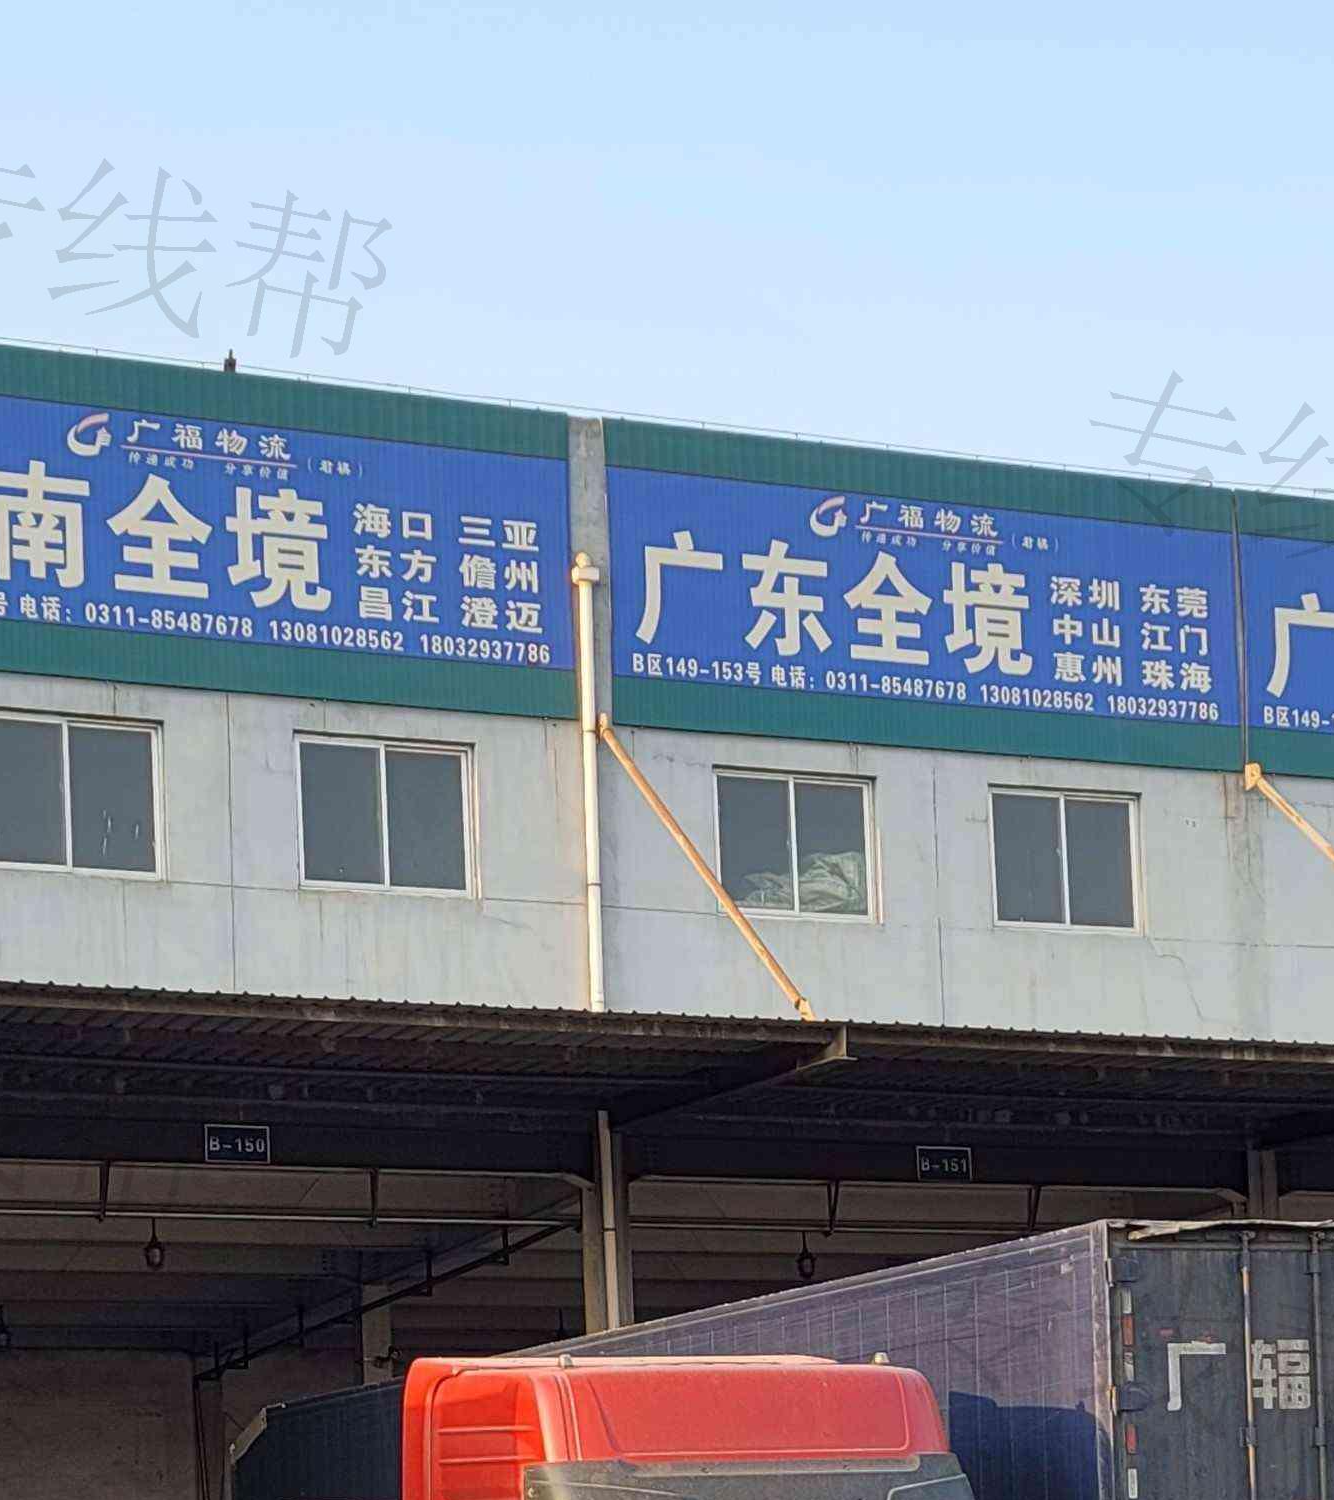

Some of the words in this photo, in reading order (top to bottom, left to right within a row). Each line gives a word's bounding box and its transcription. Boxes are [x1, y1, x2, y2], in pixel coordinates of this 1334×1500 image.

[126, 414, 292, 461] 广福物流
[354, 502, 433, 542] 海口
[459, 515, 539, 553] 三亚
[859, 500, 999, 538] 广福物流
[355, 546, 437, 584] 东方
[460, 555, 539, 593] 儋州
[359, 586, 440, 623] 昌江
[460, 597, 544, 634] 澄迈
[635, 530, 1034, 677] 广东全境
[1049, 575, 1120, 612] 深圳
[1139, 583, 1209, 620] 东莞
[84, 602, 254, 639] 0311-85487678
[268, 619, 405, 653] 13081028562
[420, 633, 551, 665] 18032937786
[1052, 613, 1120, 649] 中山
[1140, 621, 1209, 656] 江门
[632, 653, 762, 686] B区149-153号
[826, 669, 967, 701] 0311-85487678
[980, 683, 1095, 714] 13081028562
[1107, 695, 1220, 722] 18032937786
[1053, 651, 1123, 688] 惠州
[1142, 658, 1212, 694] 珠海
[208, 1136, 266, 1153] B-150
